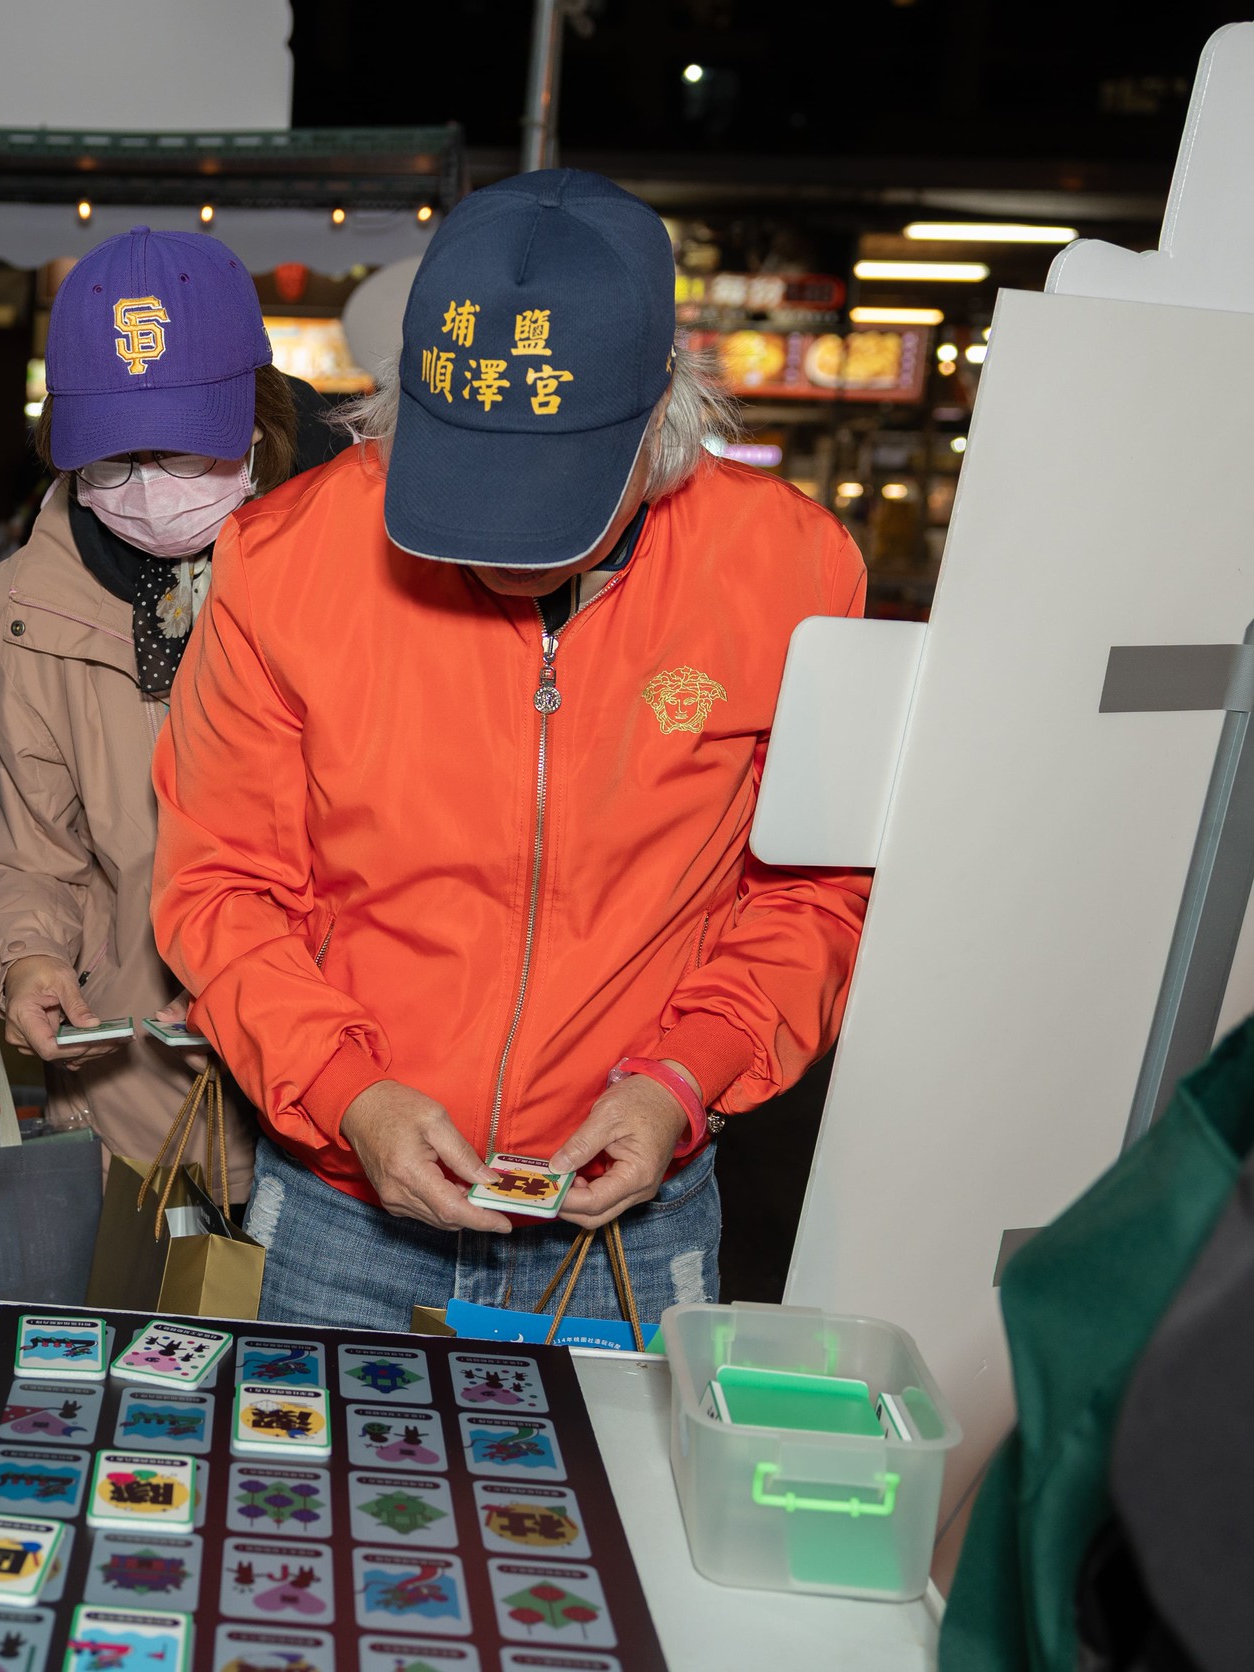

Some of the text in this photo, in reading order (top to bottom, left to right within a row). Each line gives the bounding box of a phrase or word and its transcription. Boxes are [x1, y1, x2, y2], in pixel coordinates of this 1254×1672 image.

[442, 299, 552, 357] 埔鹽
[422, 346, 575, 415] 順澤宮
